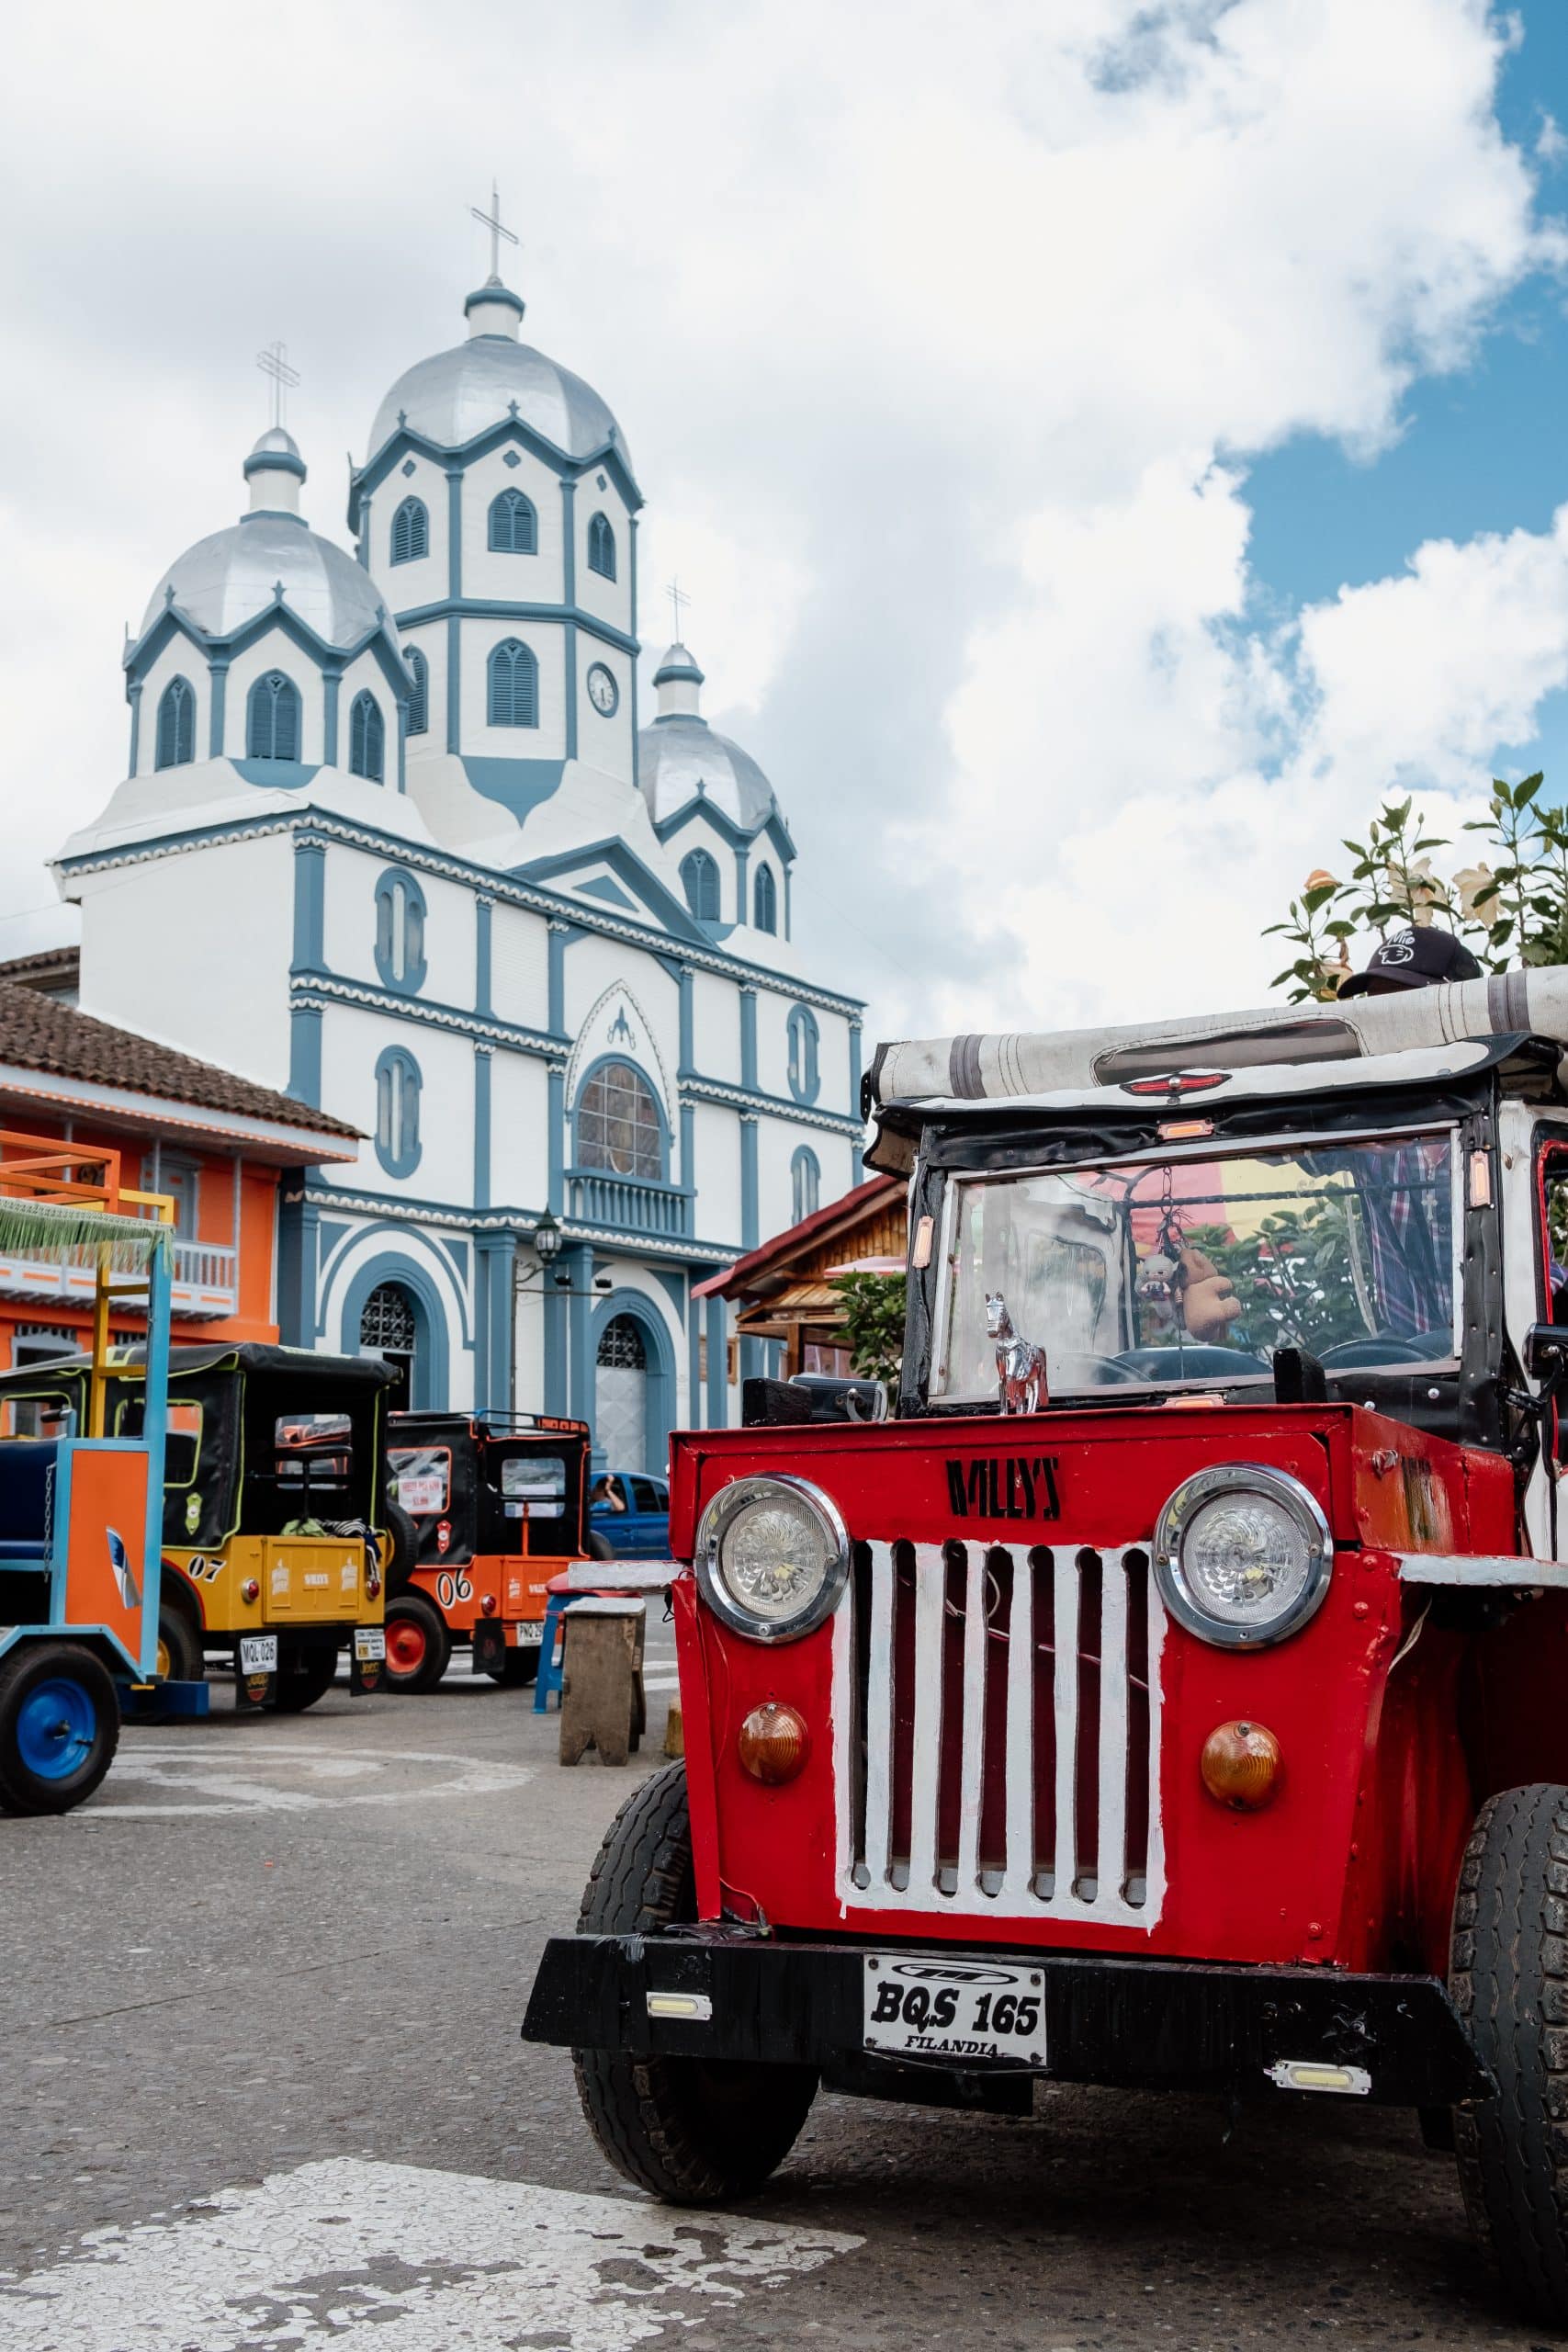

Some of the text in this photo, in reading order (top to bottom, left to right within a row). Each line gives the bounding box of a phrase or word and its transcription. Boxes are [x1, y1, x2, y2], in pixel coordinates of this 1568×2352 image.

[945, 1456, 1061, 1521] WILLYS
[187, 1555, 227, 1583] 07
[436, 1568, 474, 1610] 06
[870, 1980, 1042, 2036] BQS 165
[904, 2035, 999, 2056] FILANDIA
